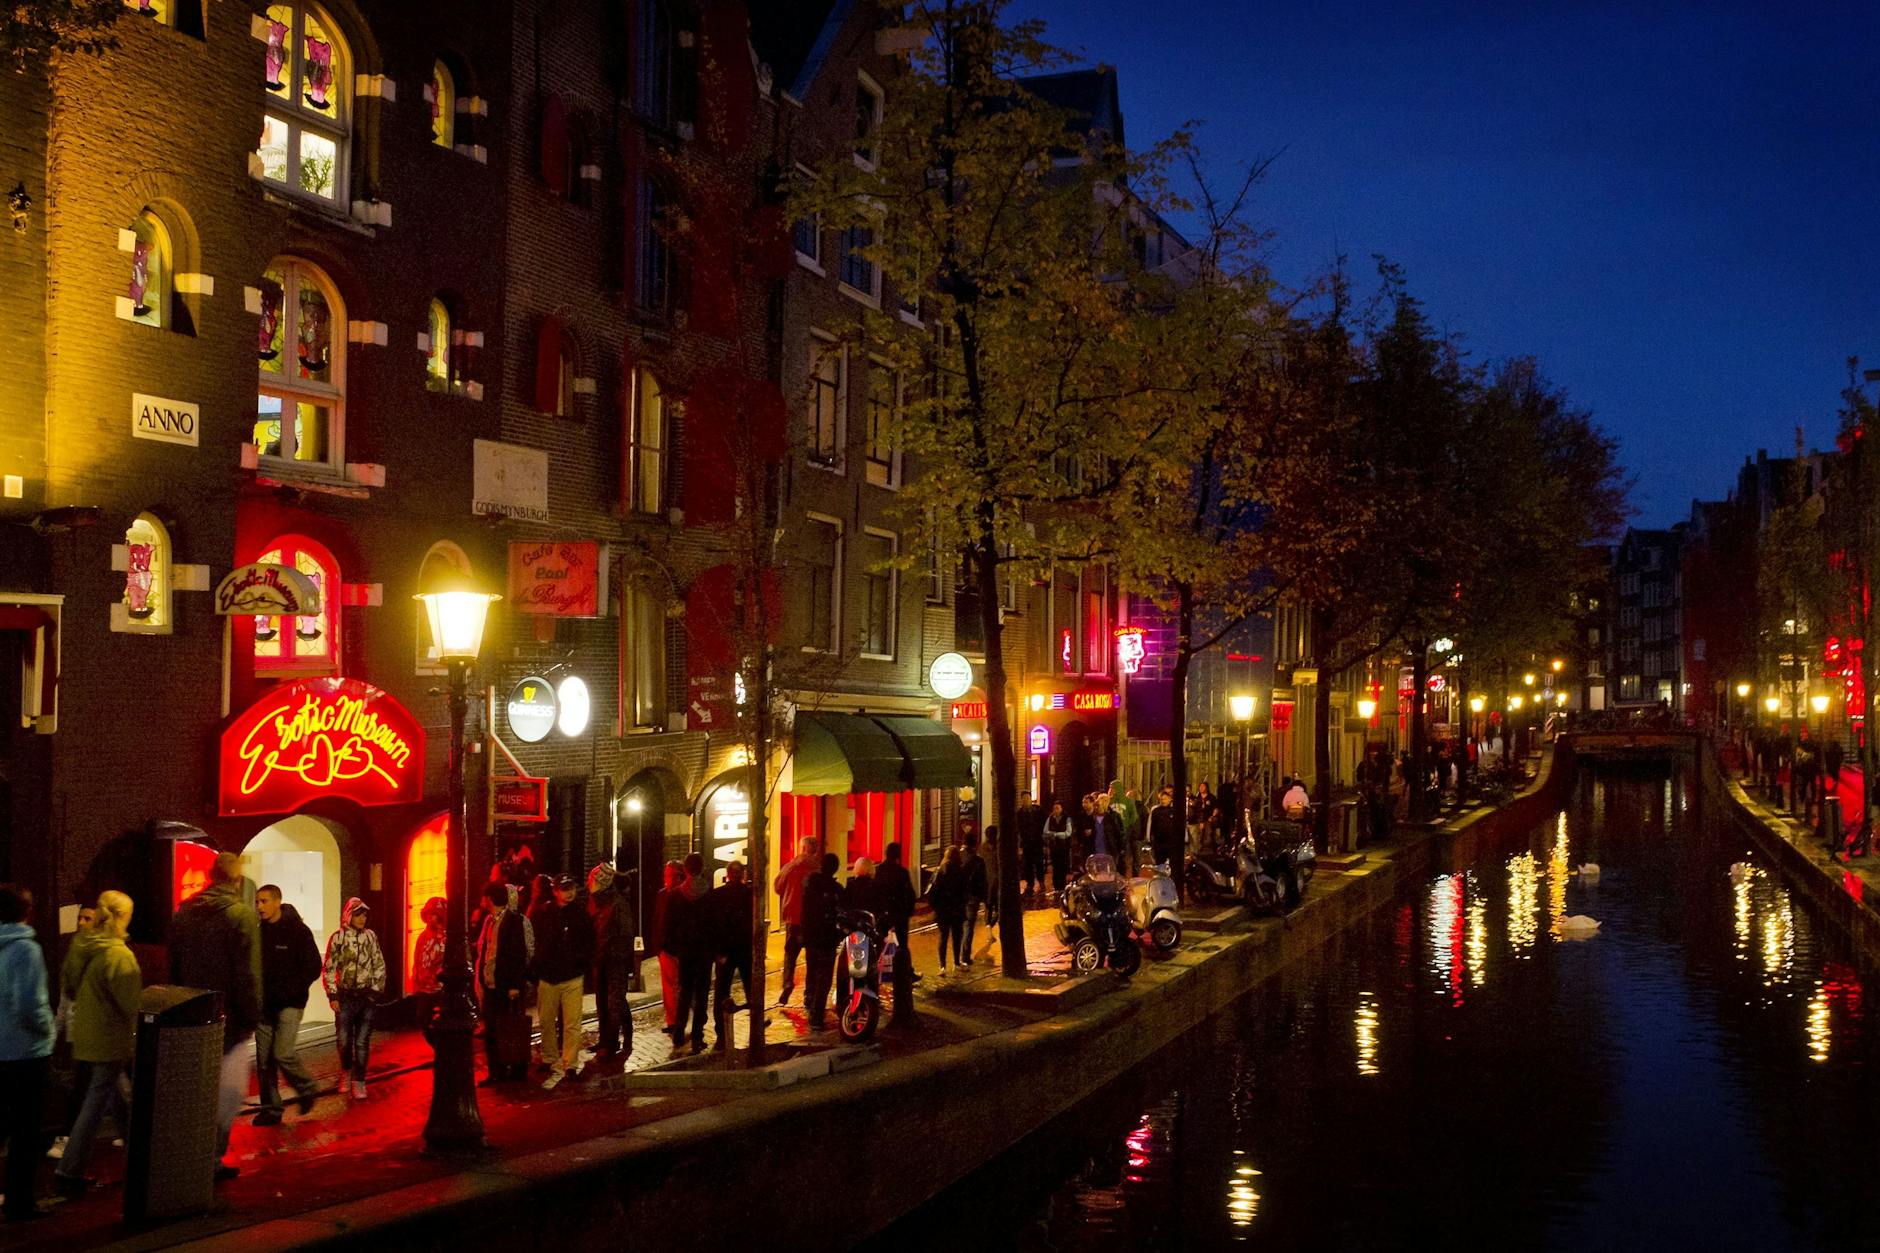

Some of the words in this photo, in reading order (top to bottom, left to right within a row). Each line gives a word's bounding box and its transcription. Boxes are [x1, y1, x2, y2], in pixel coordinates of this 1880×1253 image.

[139, 405, 194, 434] ANNO
[1074, 693, 1094, 710] CASA
[239, 693, 335, 795] Erotic
[335, 695, 411, 768] Museum
